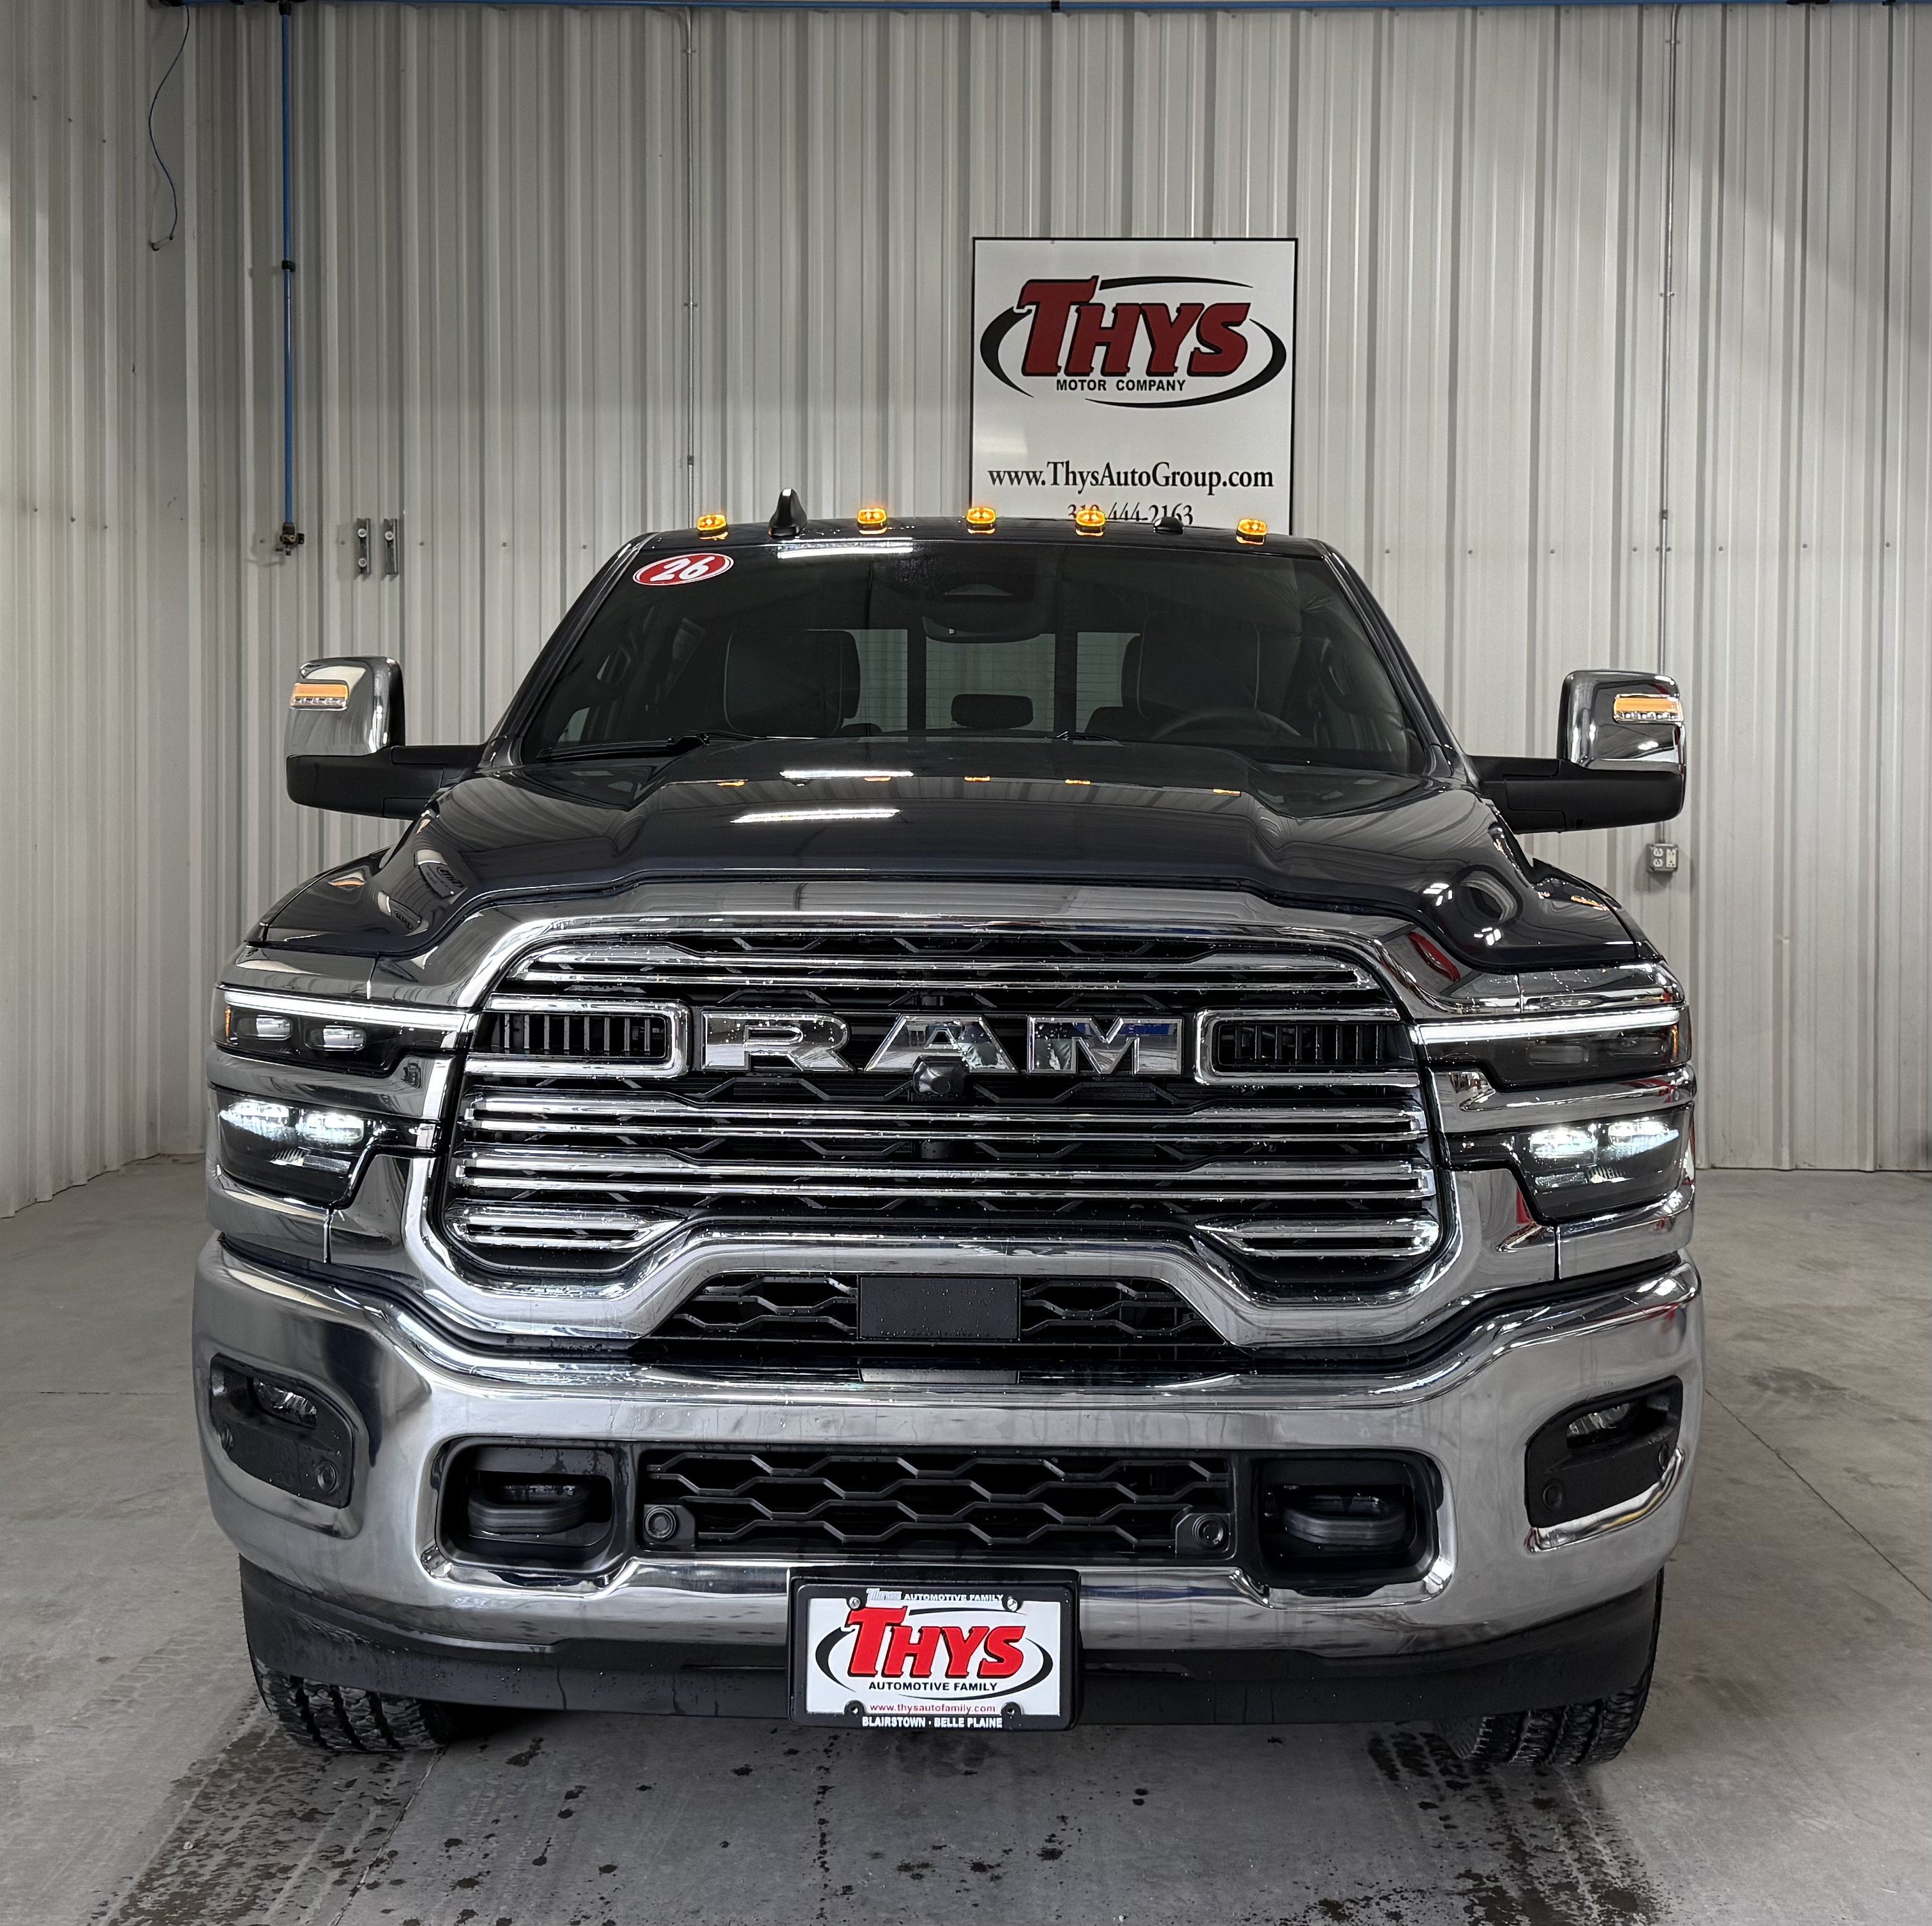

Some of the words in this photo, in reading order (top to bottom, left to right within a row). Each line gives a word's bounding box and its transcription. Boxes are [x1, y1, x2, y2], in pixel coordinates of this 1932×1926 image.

[1016, 275, 1251, 376] THYS
[1056, 379, 1107, 391] MOTOR
[1116, 379, 1186, 391] COMPANY
[988, 461, 1274, 495] www.ThysAutoGroup.com
[650, 556, 715, 582] 26
[702, 1012, 1183, 1075] RAM
[846, 1606, 1026, 1679] THYS
[868, 1682, 949, 1691] AUTOMOTIVE
[954, 1682, 997, 1692] FAMILY
[862, 1716, 926, 1728] BLAIRSTOWN
[934, 1717, 965, 1728] BELLE
[967, 1717, 1002, 1728] PLAINE
[870, 1703, 996, 1715] www.thysautofamily.com
